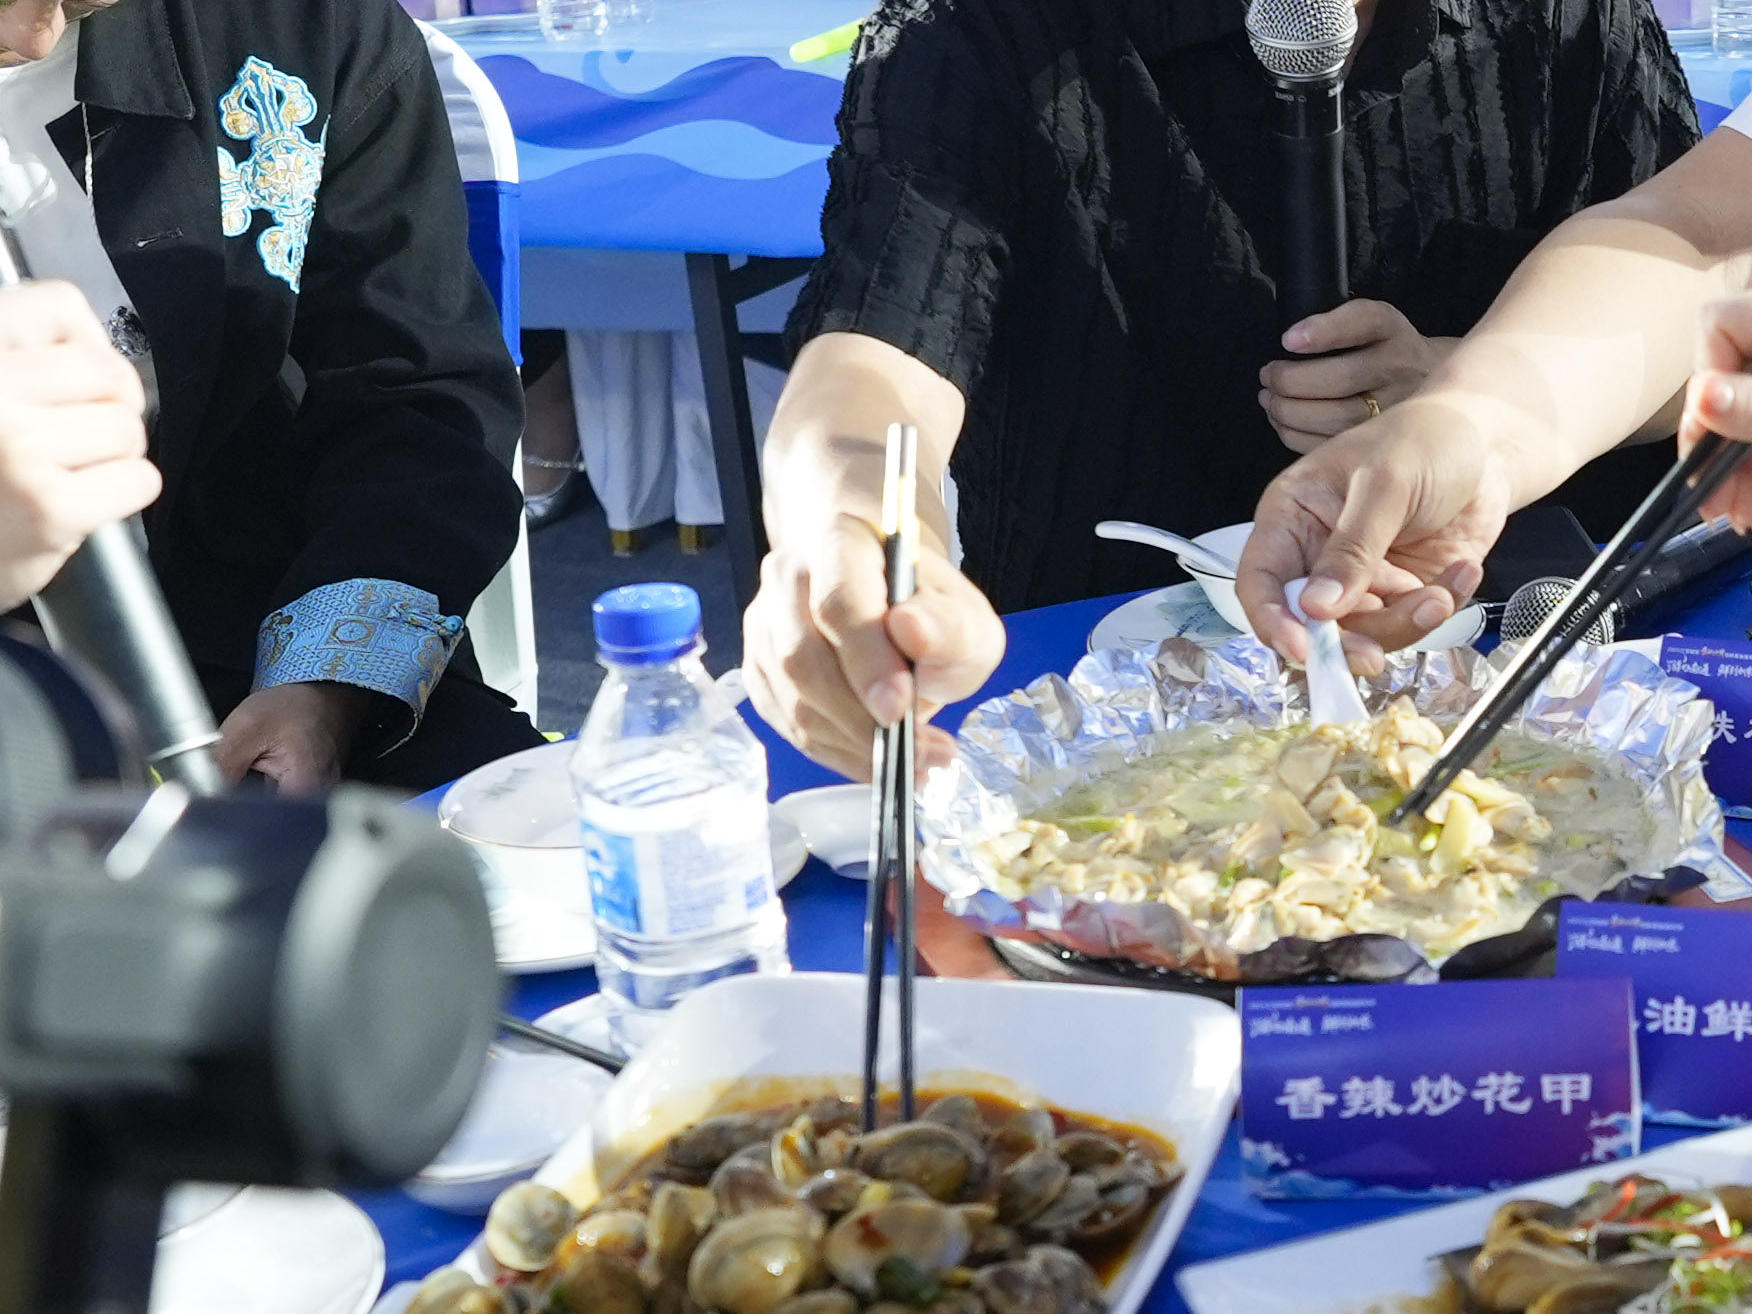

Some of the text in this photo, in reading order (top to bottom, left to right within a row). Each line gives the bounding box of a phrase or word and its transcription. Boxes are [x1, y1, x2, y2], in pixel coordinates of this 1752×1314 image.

[1275, 1070, 1593, 1120] 香辣炒花甲
